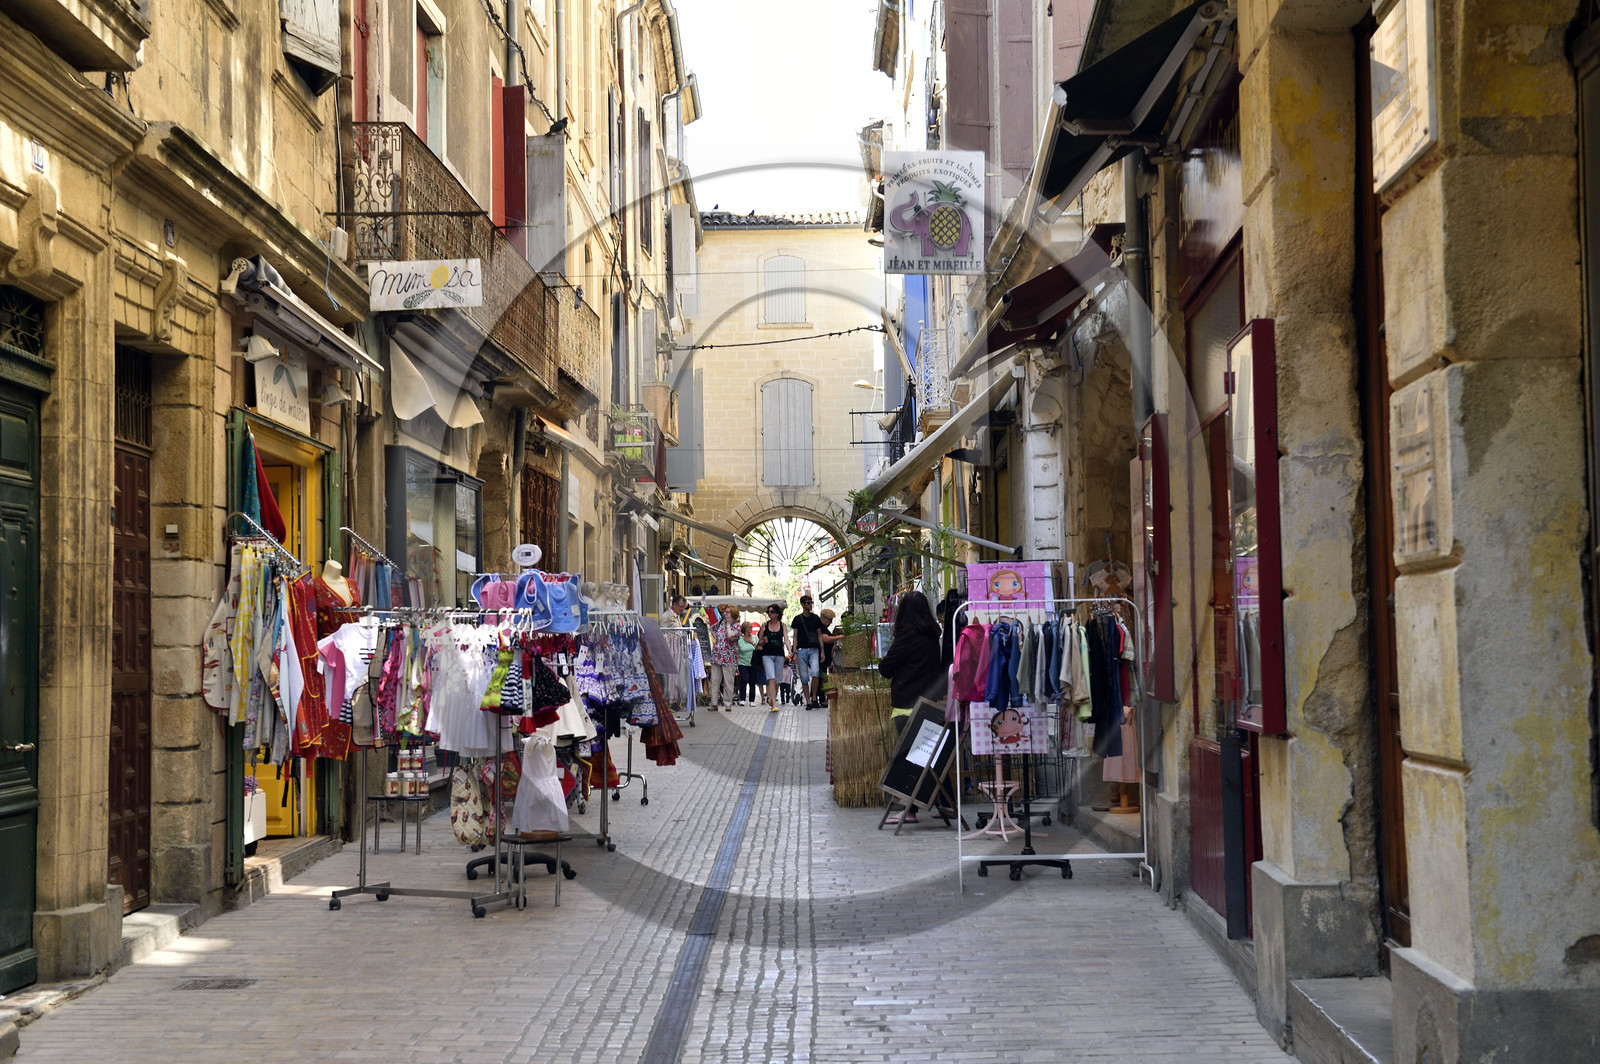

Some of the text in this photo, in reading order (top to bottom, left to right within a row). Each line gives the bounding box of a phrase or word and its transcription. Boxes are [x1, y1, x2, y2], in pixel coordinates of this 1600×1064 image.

[896, 168, 973, 188] PRODUITS EXOTIQUES
[945, 159, 954, 167] ET
[956, 163, 982, 189] LEGUMES
[887, 260, 981, 271] JEAN ET MIREILLE
[279, 387, 287, 413] de
